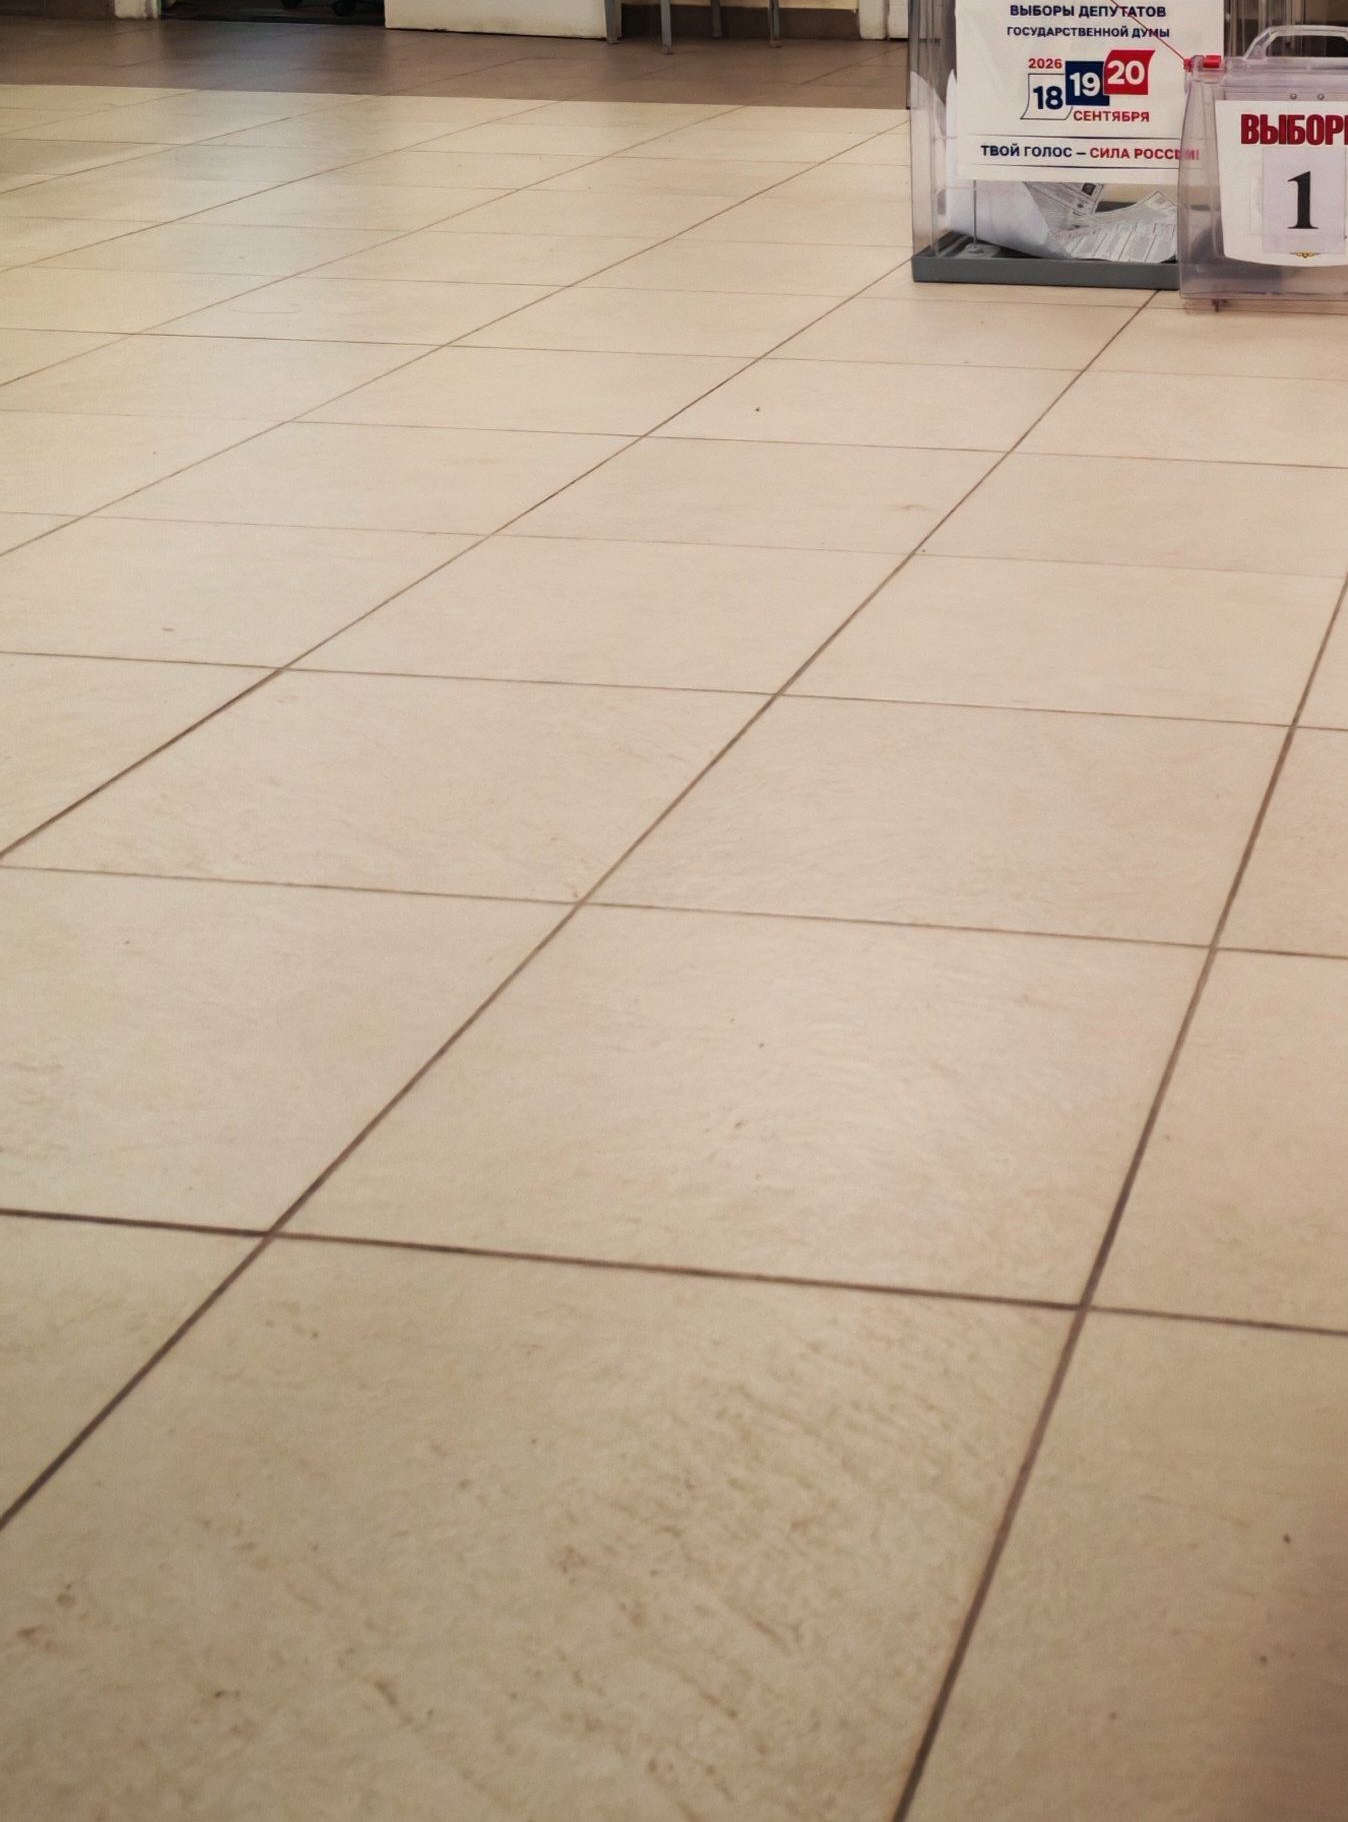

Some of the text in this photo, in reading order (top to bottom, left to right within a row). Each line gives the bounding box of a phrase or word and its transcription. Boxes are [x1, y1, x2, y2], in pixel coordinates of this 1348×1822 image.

[1009, 4, 1166, 19] ВЫБОРЫ ДЕПУТАТОВ
[1006, 25, 1170, 39] ГОСУДАРСТВЕННОЙ ДУМЫ
[1027, 58, 1063, 70] 2026
[1033, 60, 1146, 110] 18 19 20
[1073, 110, 1150, 123] СЕНТЯБРЯ
[980, 145, 1020, 158] ТВОЙ
[1024, 147, 1073, 158] ГОЛОС
[1090, 147, 1131, 159] СИЛА
[1287, 170, 1319, 230] 1
